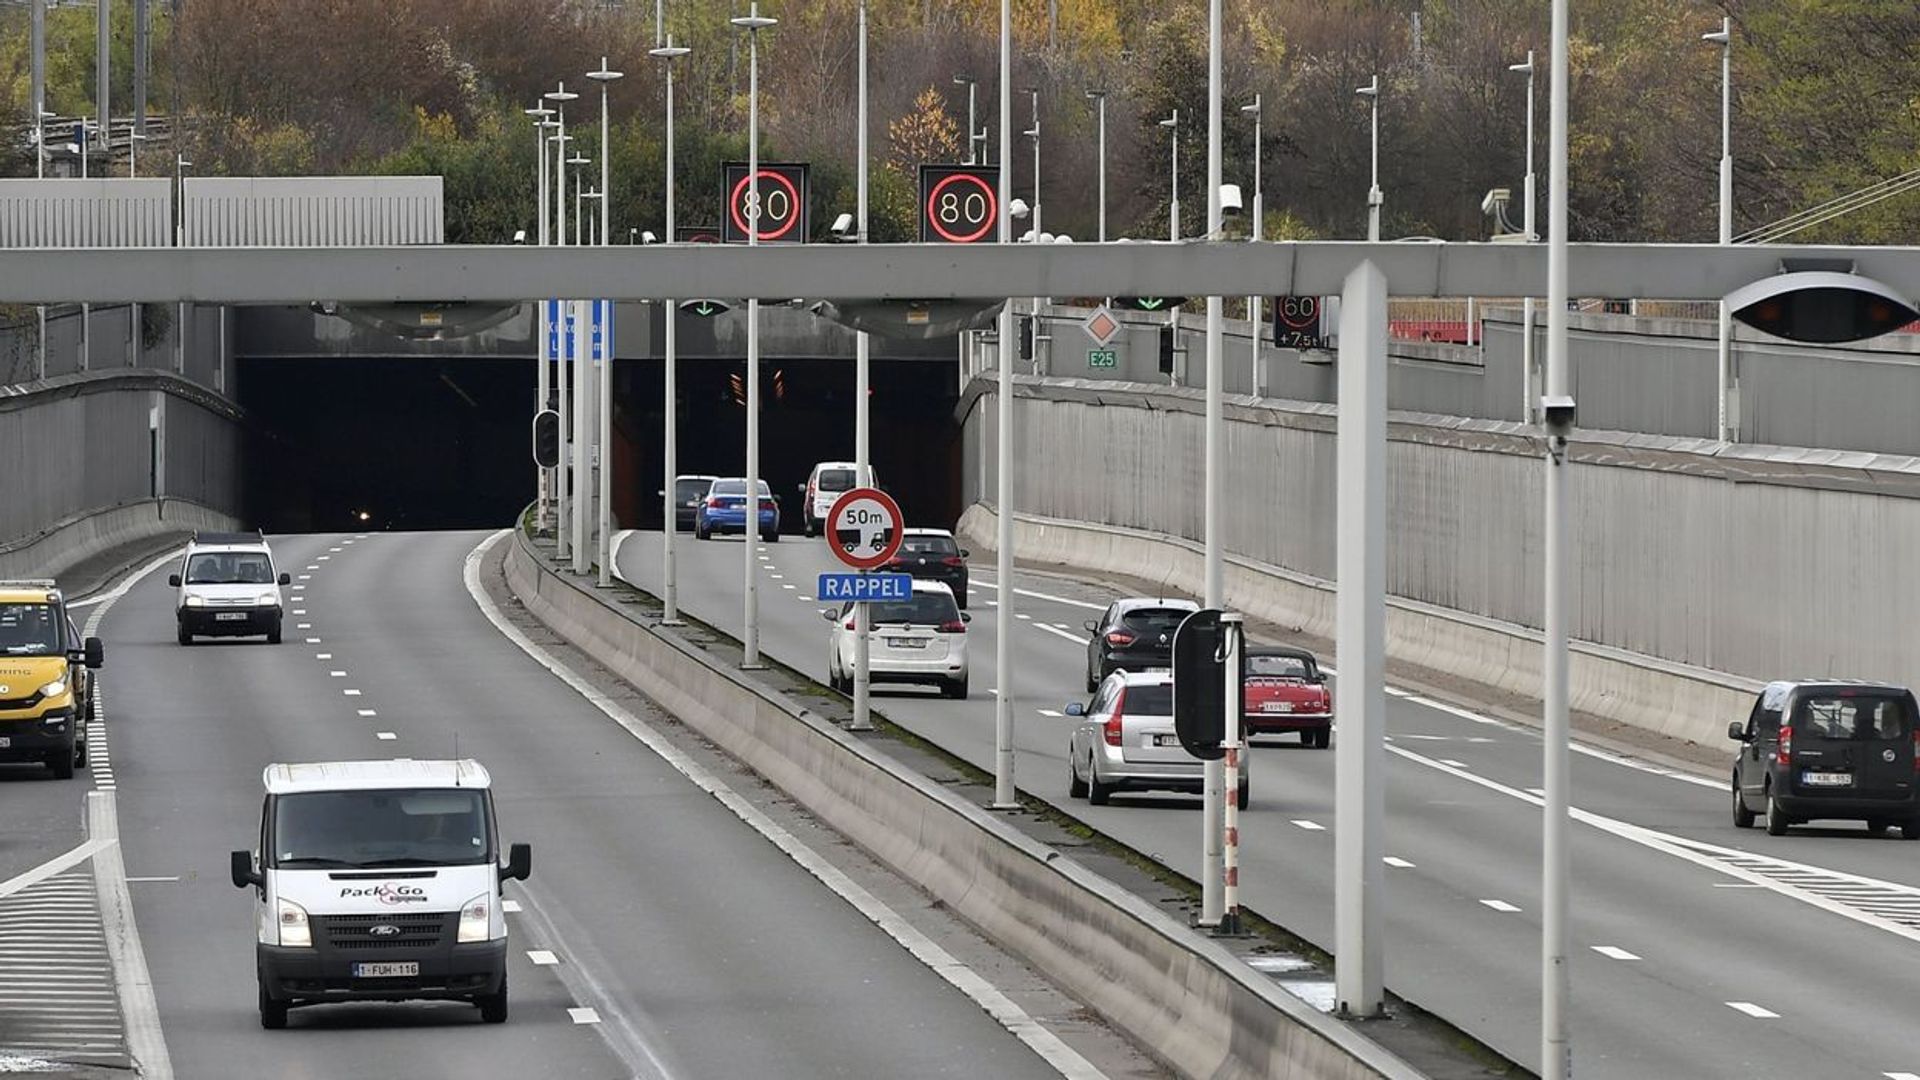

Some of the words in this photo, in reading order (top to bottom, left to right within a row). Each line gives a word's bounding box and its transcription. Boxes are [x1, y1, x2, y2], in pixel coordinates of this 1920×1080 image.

[743, 190, 788, 220] 80
[940, 193, 985, 223] 80
[1285, 296, 1314, 316] 60
[1090, 352, 1114, 366] E25
[846, 509, 883, 524] 50m
[826, 578, 904, 597] RAPPEL
